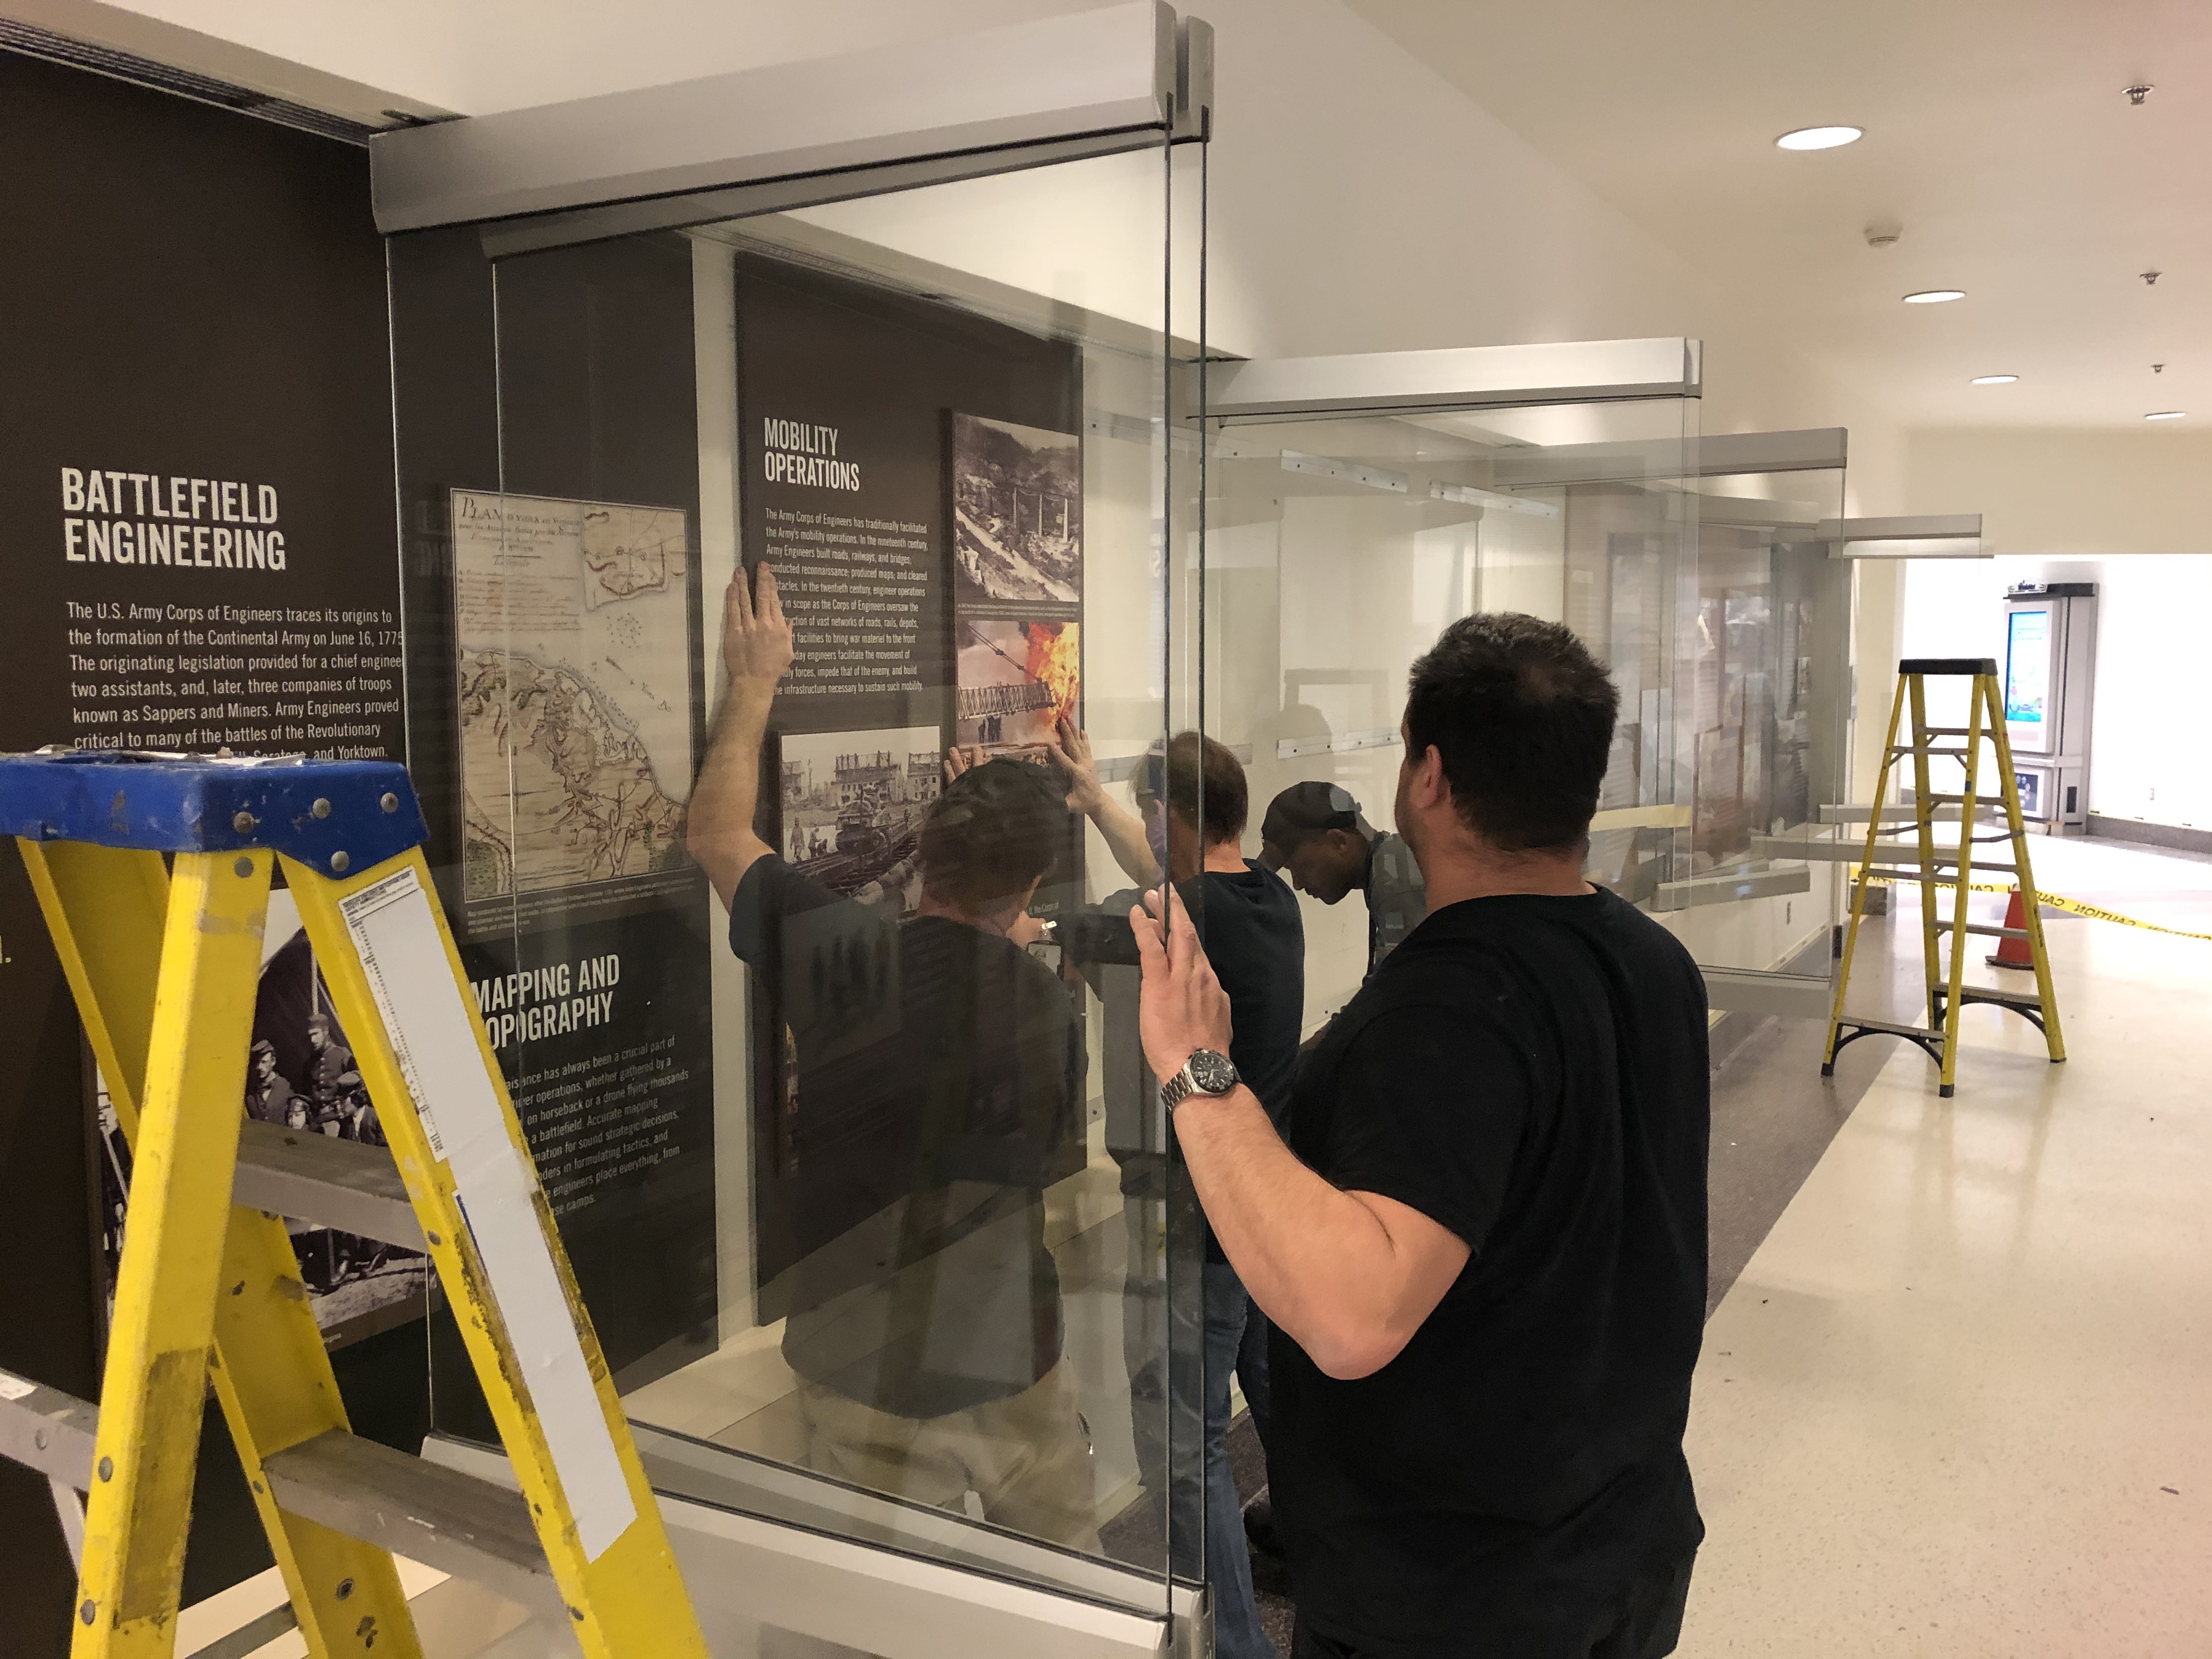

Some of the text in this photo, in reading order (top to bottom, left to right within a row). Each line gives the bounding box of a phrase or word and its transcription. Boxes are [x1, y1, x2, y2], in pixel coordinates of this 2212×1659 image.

[764, 417, 838, 456] MOBILITY
[765, 451, 860, 492] OPERATIONS
[61, 467, 278, 524] BATTLEFIELD
[765, 508, 927, 533] The Army Corps of Engineers has traditionally facilitated
[64, 518, 286, 571] ENGINEERING
[766, 527, 777, 537] the
[801, 530, 825, 543] mobility
[860, 534, 866, 544] In
[867, 535, 877, 545] the
[878, 536, 906, 548] nineteenth
[766, 544, 783, 557] Army
[785, 545, 815, 558] Engineers
[816, 548, 831, 558] built
[878, 552, 889, 562] and
[768, 564, 928, 580] onducted produced and cleared
[802, 582, 808, 591] In
[809, 582, 819, 592] the
[820, 583, 848, 593] twentieth
[873, 585, 897, 597] engineer
[898, 586, 926, 597] operations
[66, 603, 392, 626] The U.S. Army Corps of Engineers traces its origins to
[786, 599, 792, 608] in
[793, 601, 811, 611] scope
[821, 600, 831, 609] the
[833, 600, 850, 612] Corps
[851, 601, 857, 610] of
[858, 601, 885, 612] Engineers
[910, 602, 918, 612] the
[809, 617, 815, 625] of
[816, 618, 830, 626] vast
[831, 617, 857, 627] networks
[859, 618, 864, 627] of
[69, 629, 92, 645] the
[97, 629, 162, 645] formation
[167, 630, 179, 645] of
[183, 630, 204, 645] the
[208, 630, 278, 645] Continental
[282, 631, 310, 648] Army
[314, 634, 326, 645] on
[330, 631, 354, 645] June
[359, 631, 374, 647] 16,
[797, 634, 824, 643] facilities
[825, 634, 832, 643] to
[833, 634, 848, 645] bring
[893, 634, 902, 643] the
[903, 634, 916, 643] front
[70, 653, 403, 674] The originating legislation provided for a chief enginee
[808, 650, 904, 662] engineers facilitate the movement
[817, 667, 839, 679] impede
[840, 667, 853, 676] that
[854, 667, 860, 676] of
[861, 667, 871, 676] the
[892, 665, 902, 675] and
[904, 665, 917, 675] build
[71, 678, 392, 697] two assistants, and, later, three companies of troops
[785, 682, 900, 695] infrastructure necessary to sustain such
[74, 698, 399, 724] known as Sappers and Miners. Army Engineers proved
[74, 724, 381, 748] critical to many of the battles of the Revolutionary
[314, 747, 334, 759] and
[338, 745, 388, 759] Yorktown.
[470, 954, 619, 1013] MAPPING AND
[485, 991, 613, 1050] OPOGRAPHY
